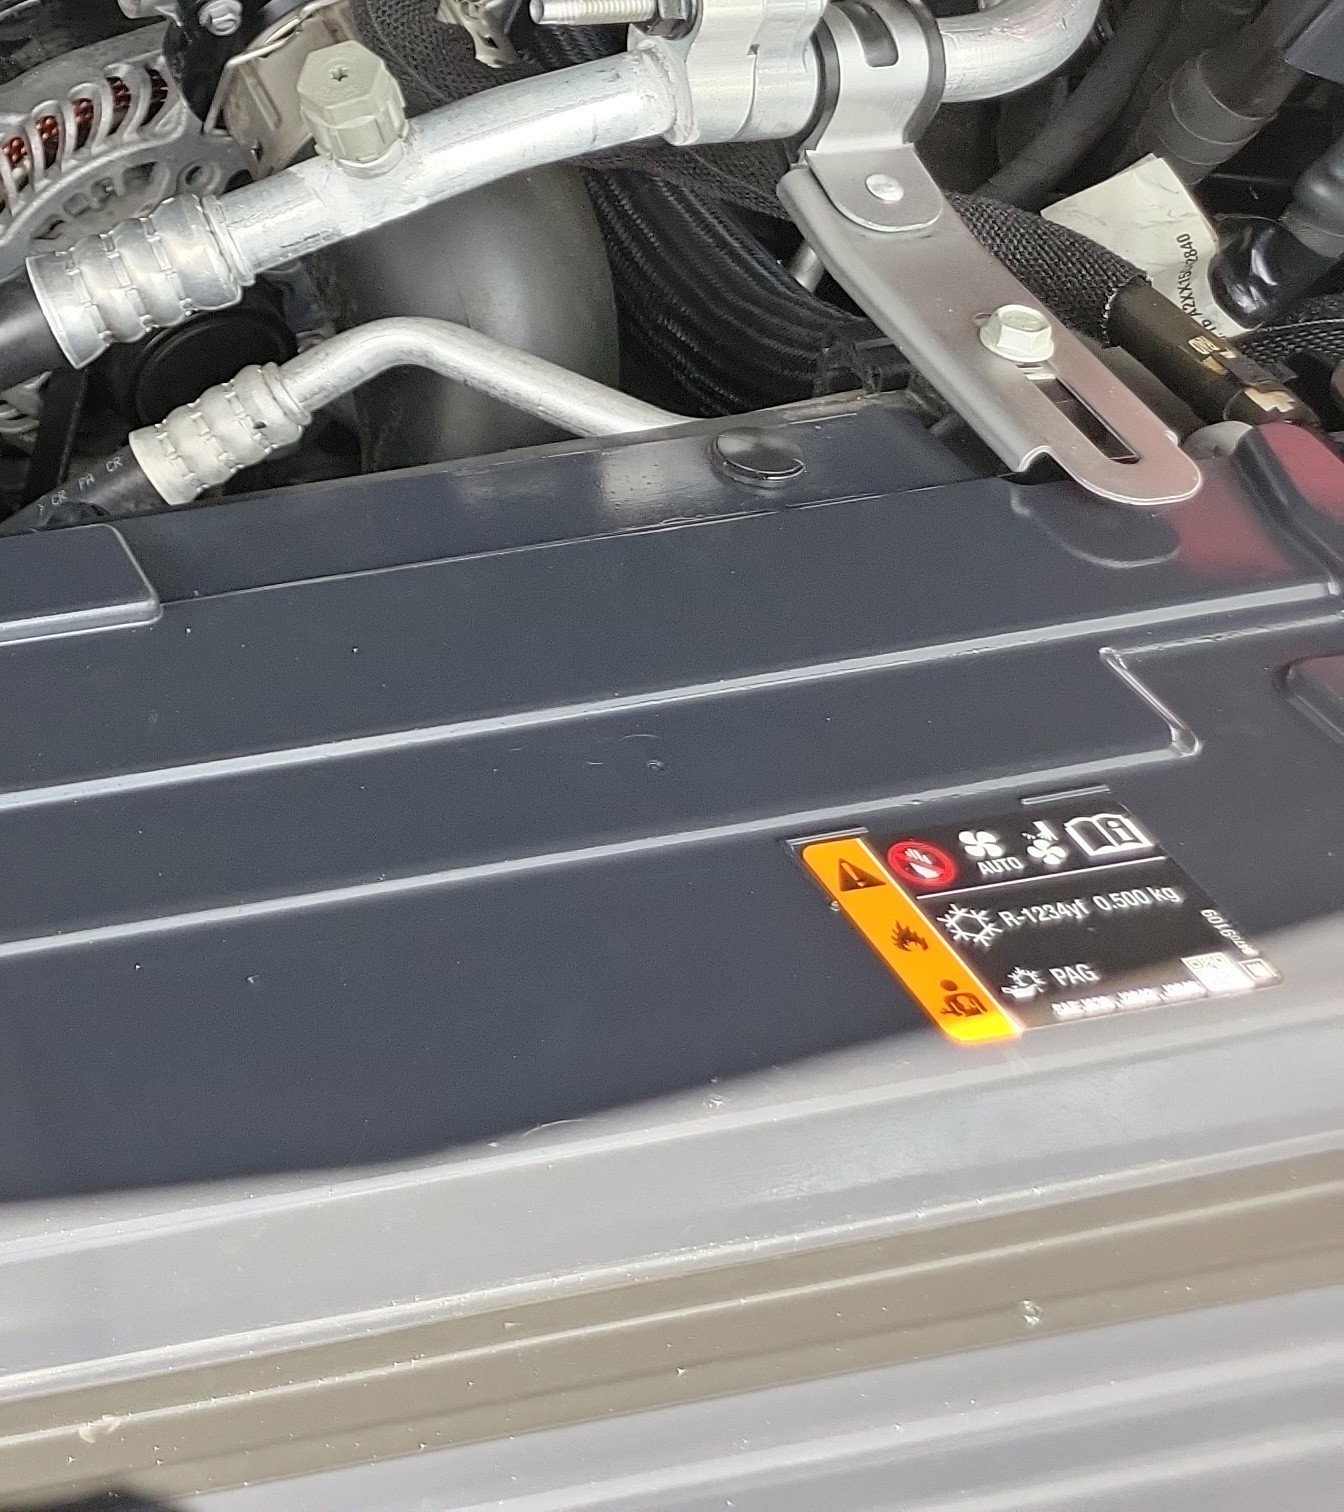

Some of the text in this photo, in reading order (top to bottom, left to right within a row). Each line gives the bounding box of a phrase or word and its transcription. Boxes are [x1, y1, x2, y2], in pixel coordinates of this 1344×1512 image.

[977, 857, 1024, 876] AUTO
[997, 886, 1183, 928] R-1234yf 0.500 kg
[1049, 963, 1100, 987] PAG
